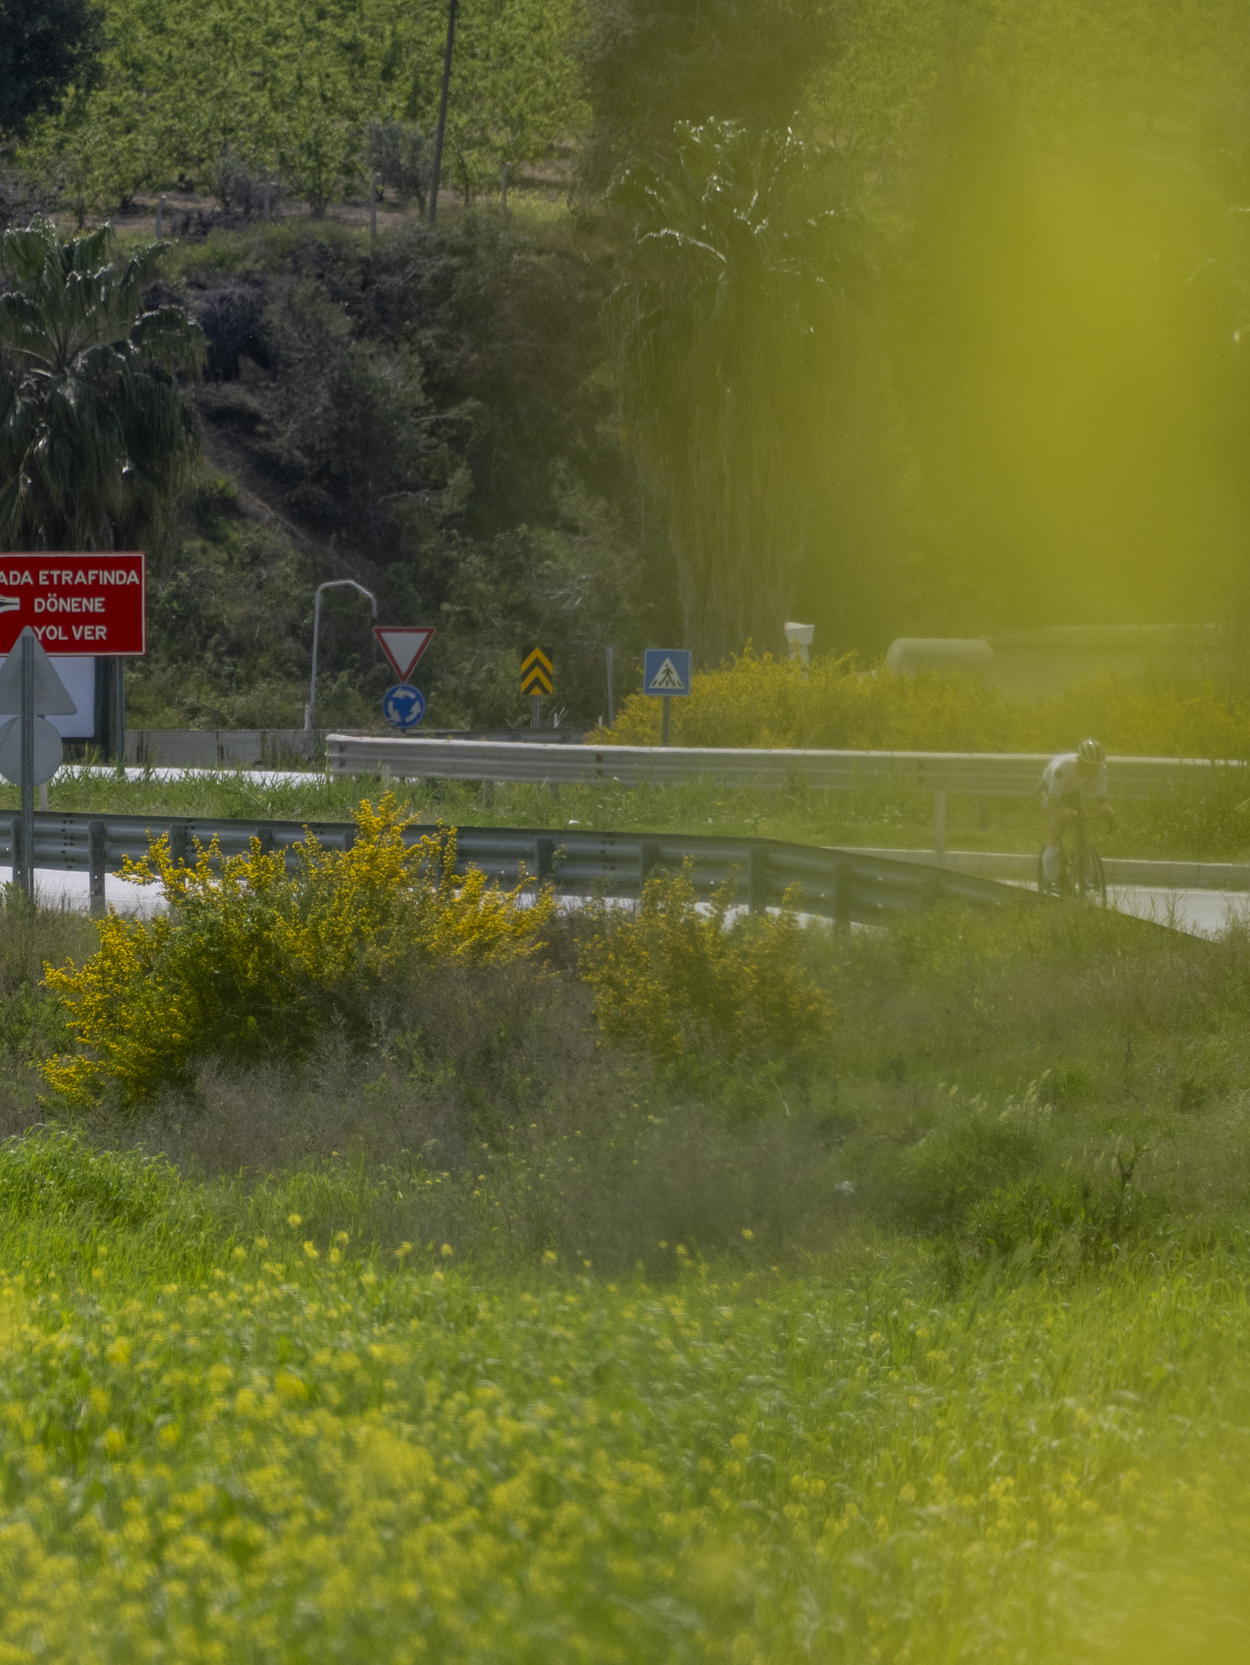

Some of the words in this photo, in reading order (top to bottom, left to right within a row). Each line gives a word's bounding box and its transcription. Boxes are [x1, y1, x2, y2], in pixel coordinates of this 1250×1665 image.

[38, 570, 140, 586] ETRAFINDA
[34, 593, 106, 613] DÖNENE
[33, 625, 68, 641] YOL
[71, 625, 107, 641] VER
